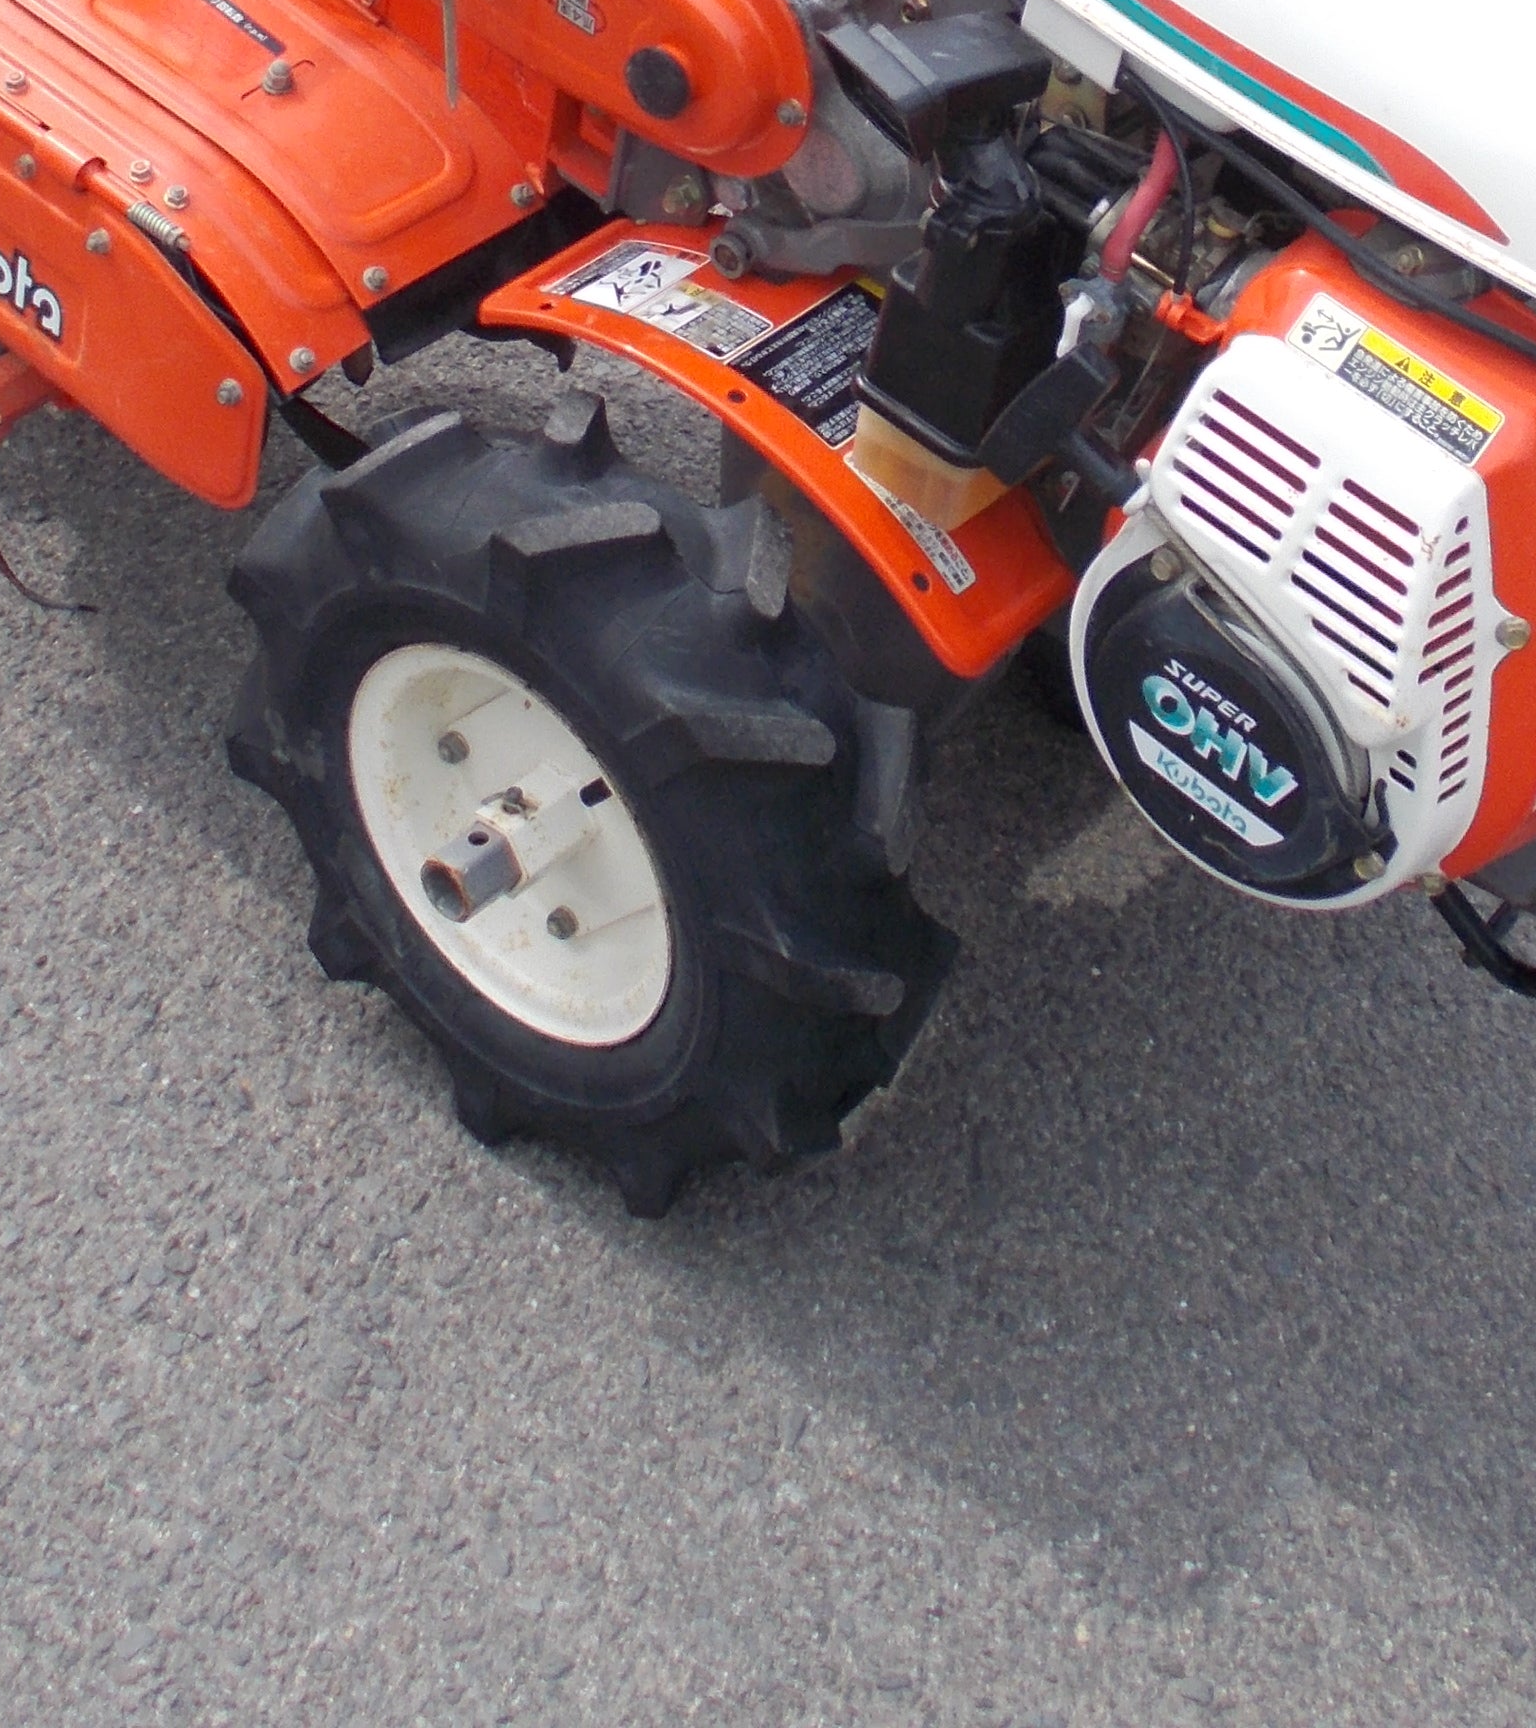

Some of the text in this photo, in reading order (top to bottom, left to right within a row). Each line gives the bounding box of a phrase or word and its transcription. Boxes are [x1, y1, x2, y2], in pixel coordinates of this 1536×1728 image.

[1164, 659, 1257, 733] SUPER
[1142, 675, 1299, 807] OHV
[1157, 750, 1247, 834] Kubota
